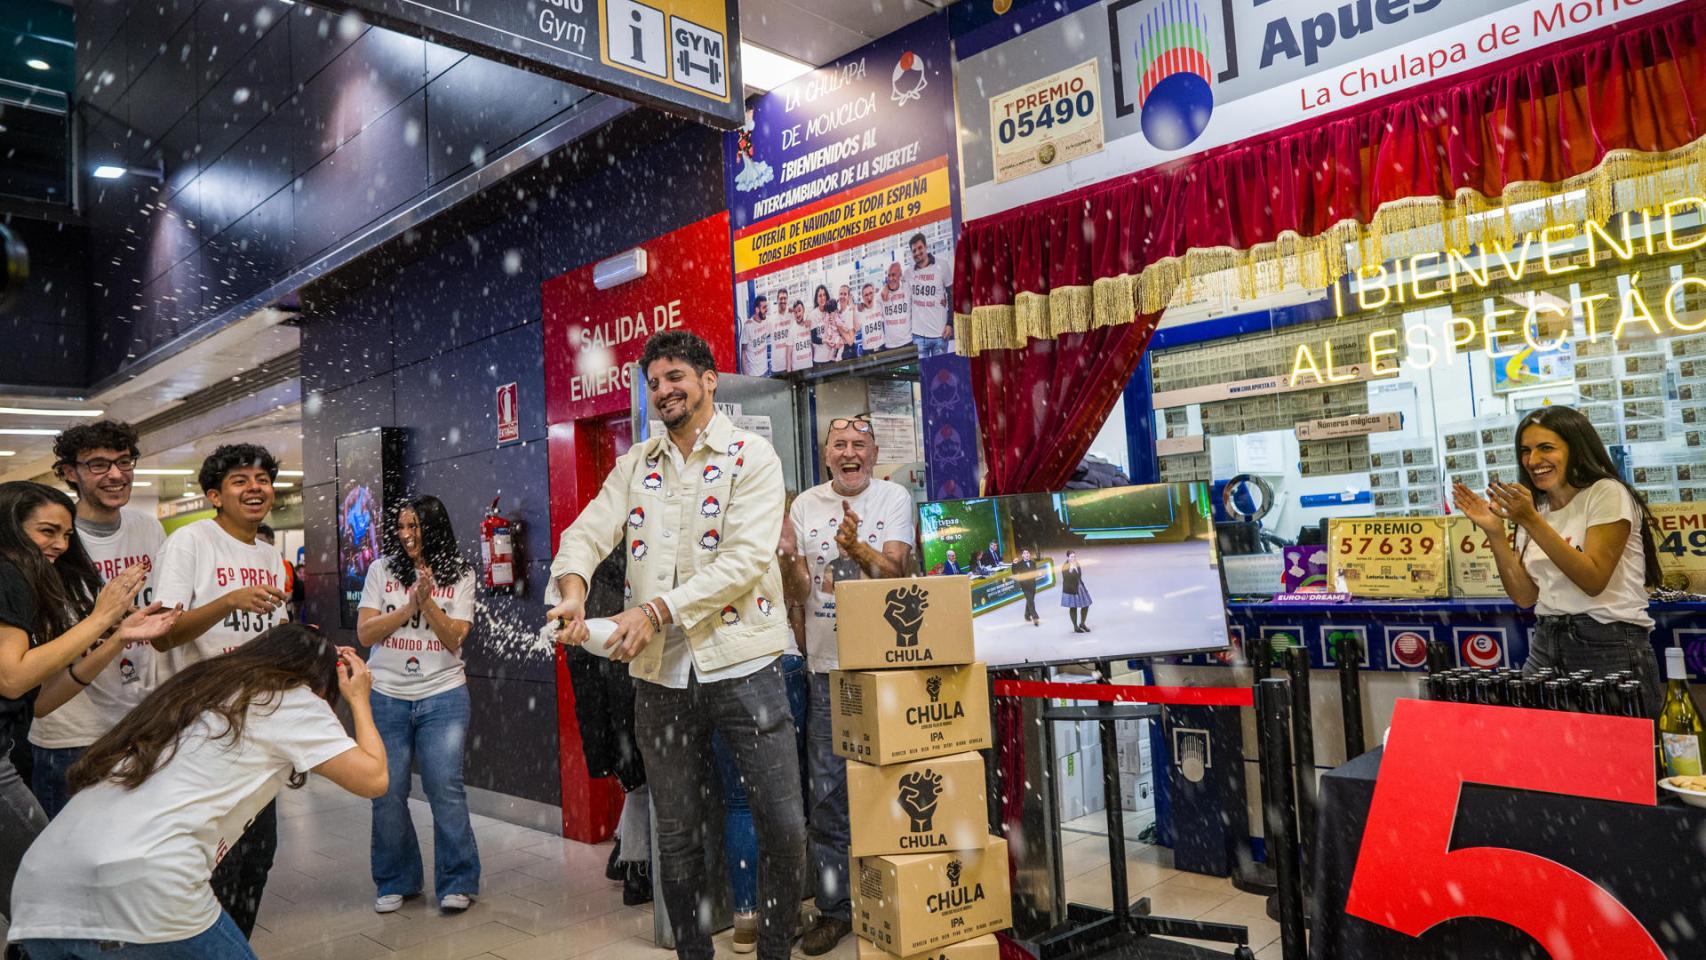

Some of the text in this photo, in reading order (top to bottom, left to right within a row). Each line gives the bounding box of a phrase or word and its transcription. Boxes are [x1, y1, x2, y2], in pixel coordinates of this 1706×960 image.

[539, 9, 586, 44] Gym
[675, 27, 720, 58] GYM
[785, 57, 866, 112] LA CHULAPA
[1301, 87, 1331, 111] La
[1339, 42, 1467, 97] Chulapa
[1477, 23, 1521, 53] de
[1016, 76, 1084, 113] PREMIO
[782, 92, 877, 151] DE MONCLOA
[998, 89, 1095, 144] 05490
[781, 127, 878, 184] ¡BIENVENIDOS AL
[753, 142, 919, 220] INTERCAMBIADOR DE LA SUERTE!
[752, 176, 928, 251] LOTERÍA DE NAVIDAD DE TODA ESPAÑA
[758, 246, 783, 265] TODAS
[784, 241, 798, 257] LAS
[799, 219, 862, 252] TERMINACIONES
[862, 216, 878, 231] DEL
[894, 206, 906, 222] AL
[907, 201, 921, 217] 99
[580, 299, 682, 353] SALIDA DE
[884, 302, 908, 316] 05490
[864, 321, 882, 335] 0549
[1289, 340, 1356, 388] AL
[570, 366, 632, 402] EMERG
[1317, 415, 1381, 430] Números mágicos
[1340, 537, 1435, 555] 57639
[1364, 522, 1423, 535] PREMIO
[885, 649, 933, 663] CHULA
[906, 701, 965, 725] CHULA
[930, 731, 944, 742] IPA
[899, 834, 948, 849] CHULA
[1345, 698, 1668, 960] 5
[926, 883, 985, 914] CHULA
[950, 916, 965, 928] IPA
